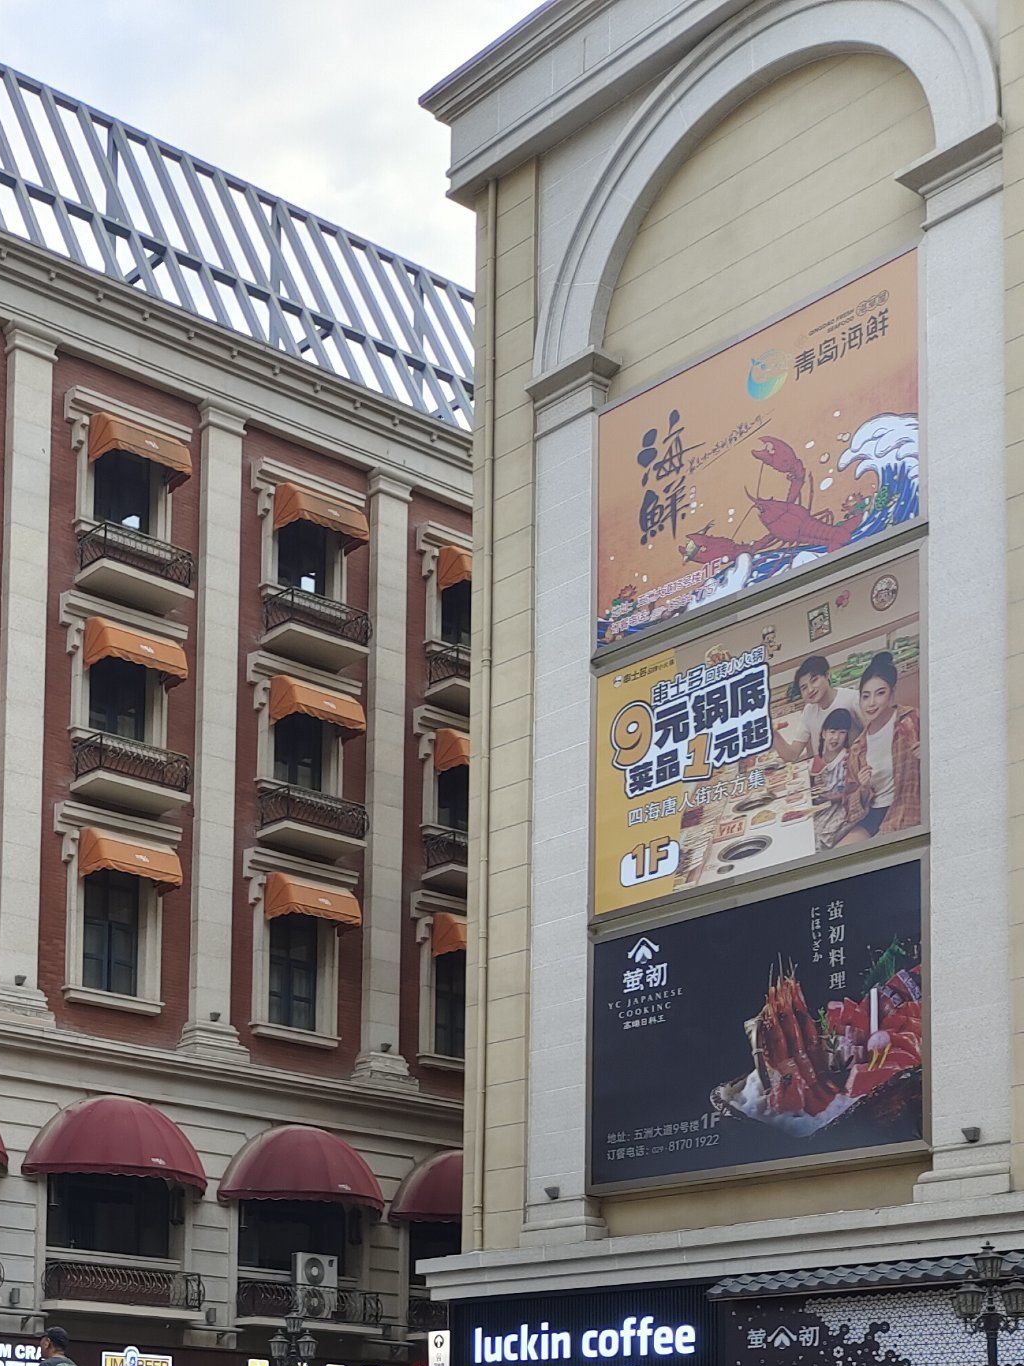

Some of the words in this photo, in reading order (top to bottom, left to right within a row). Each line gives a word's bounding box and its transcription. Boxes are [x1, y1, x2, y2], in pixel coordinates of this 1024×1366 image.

[612, 667, 767, 768] 9元锅底
[629, 715, 769, 793] 菜品1元起
[628, 770, 766, 827] 四海唐人街东方集
[631, 835, 671, 879] 1F
[827, 900, 846, 990] 萤初料理
[608, 1000, 622, 1010] YC
[627, 987, 683, 1008] JAPANESE
[623, 962, 668, 993] 萤初
[618, 1001, 672, 1019] COOKING
[14, 1343, 44, 1361] CRA
[474, 1321, 571, 1364] luckin
[581, 1316, 696, 1358] coffee
